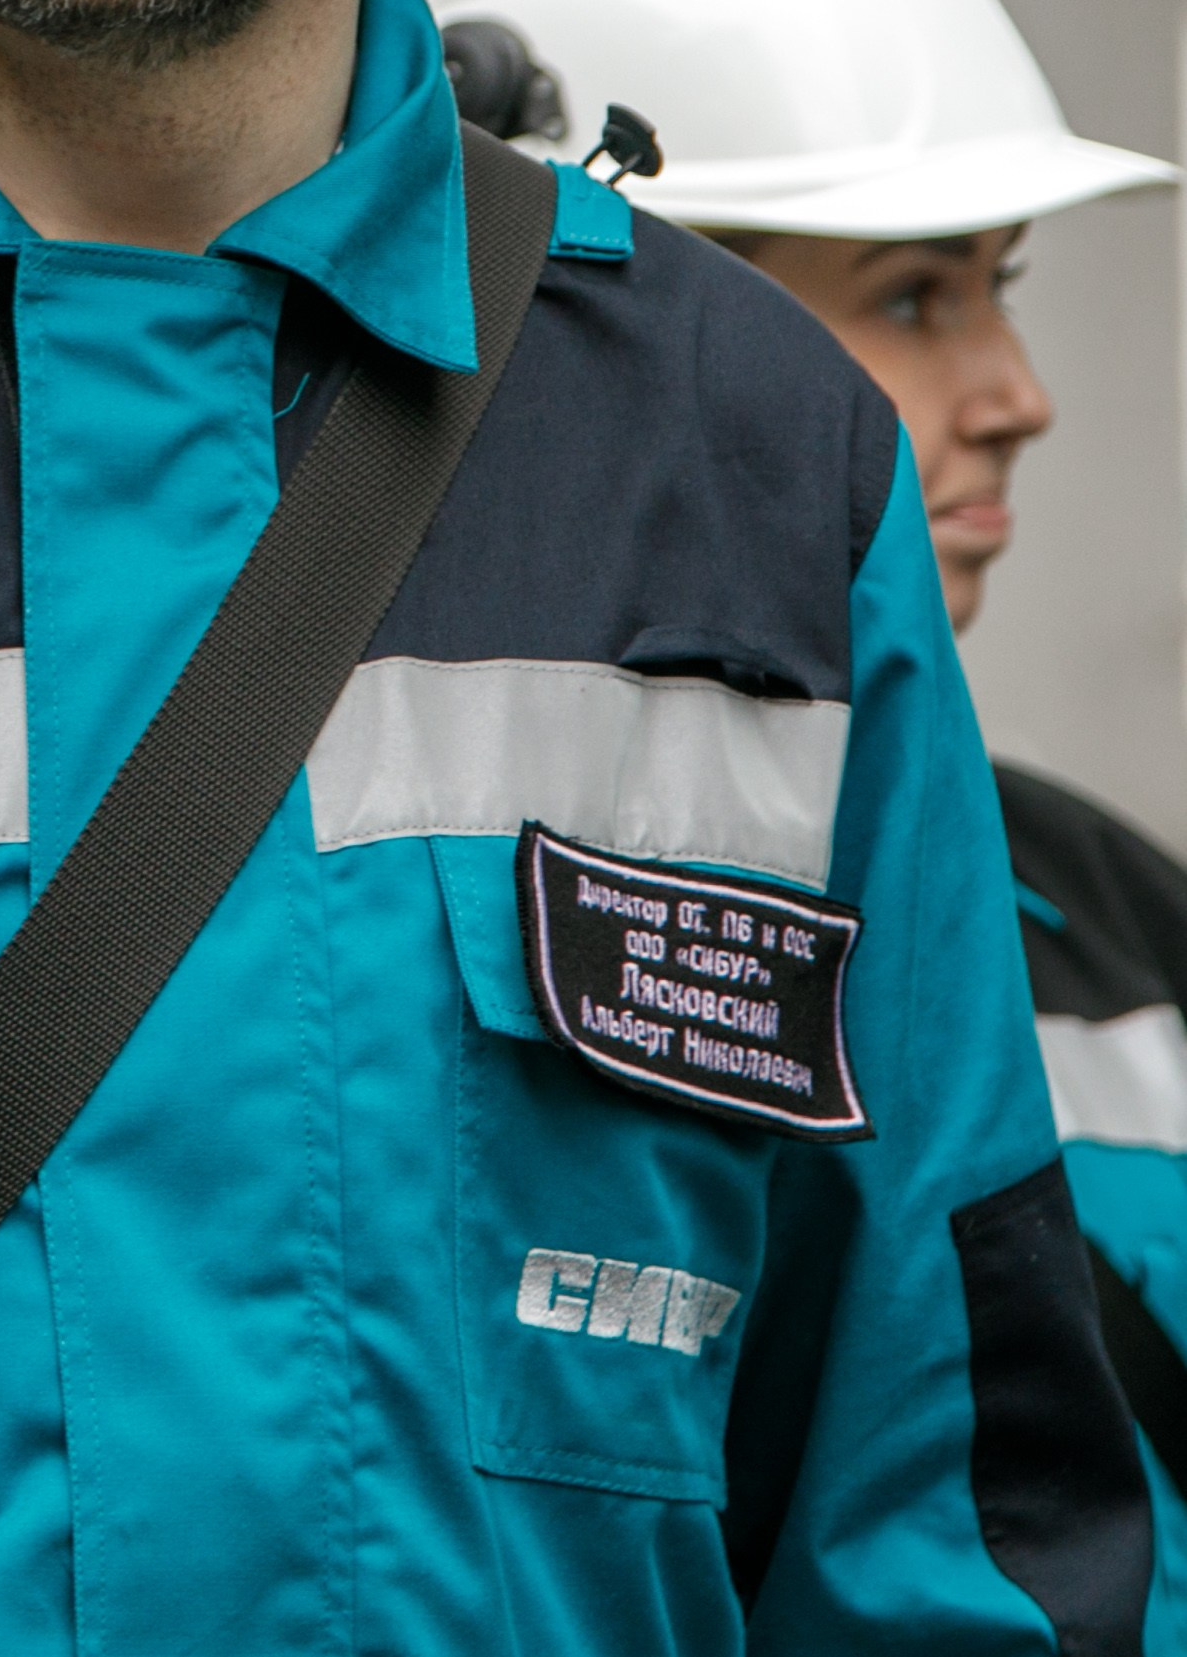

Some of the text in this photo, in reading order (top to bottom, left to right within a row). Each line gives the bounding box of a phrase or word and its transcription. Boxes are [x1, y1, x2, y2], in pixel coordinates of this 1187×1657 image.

[577, 874, 668, 929] Директор
[722, 909, 754, 943] ПБ
[625, 929, 772, 986] ООО «СИБУР»
[620, 961, 780, 1040] Лясковский
[581, 994, 814, 1098] Альберт Николаевич
